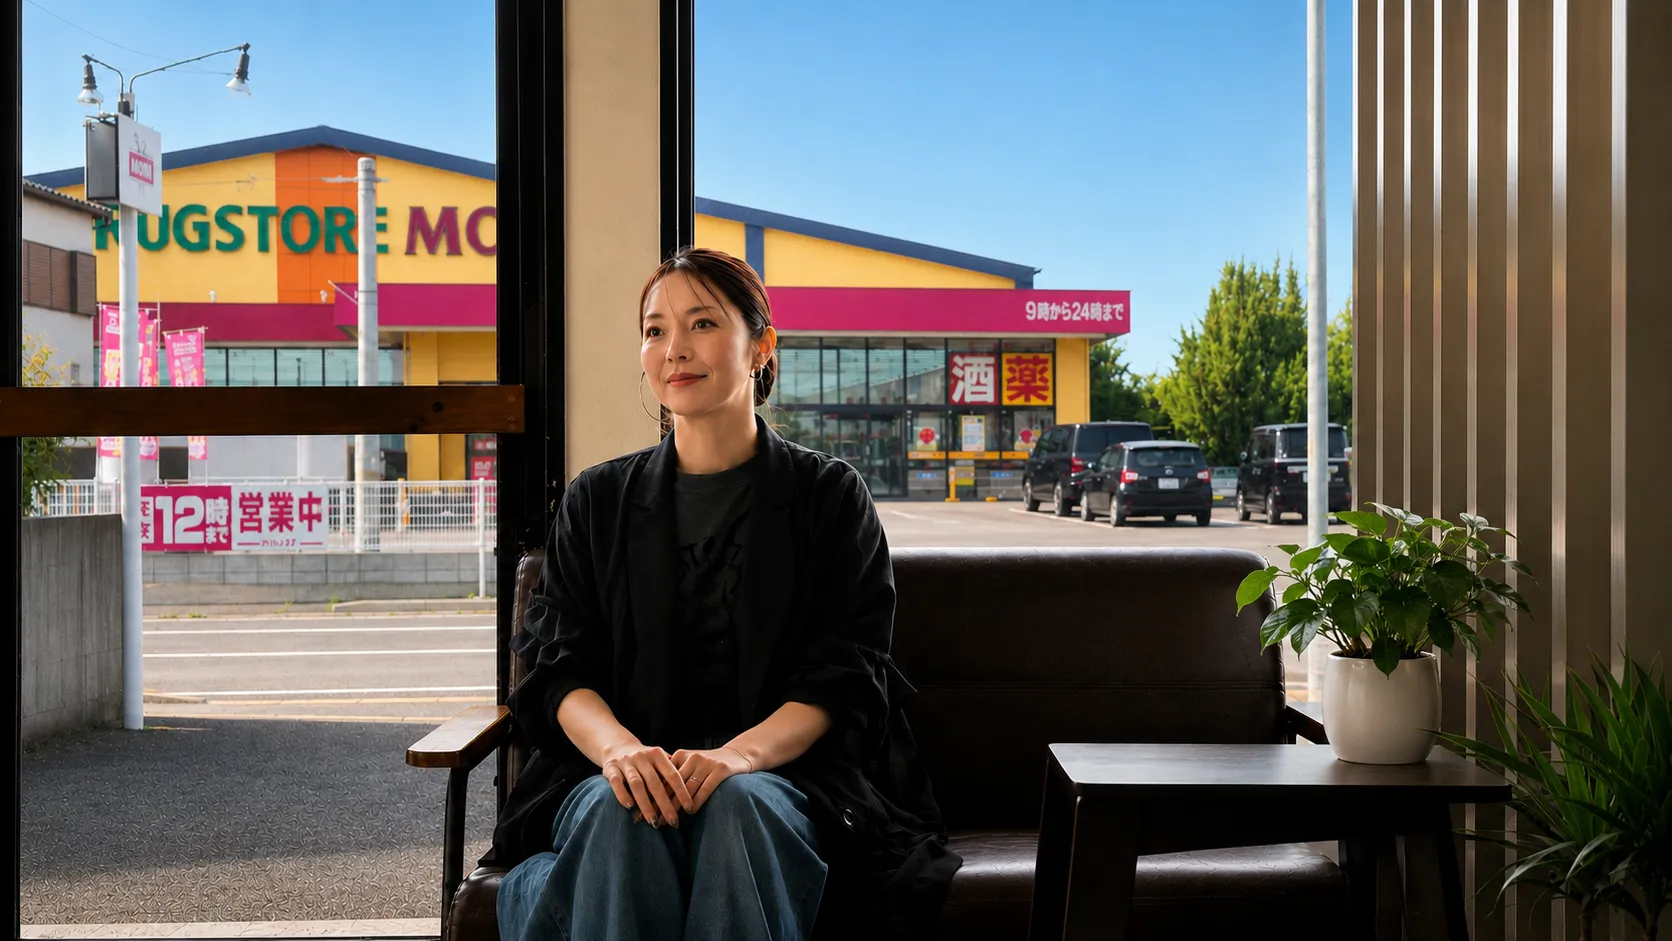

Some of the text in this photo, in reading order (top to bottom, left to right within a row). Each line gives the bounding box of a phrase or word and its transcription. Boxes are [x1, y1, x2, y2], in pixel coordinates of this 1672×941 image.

[1025, 300, 1124, 321] 9時から24時まで
[952, 355, 995, 403] 酒
[1006, 355, 1050, 403] 薬
[238, 491, 322, 533] 営業中
